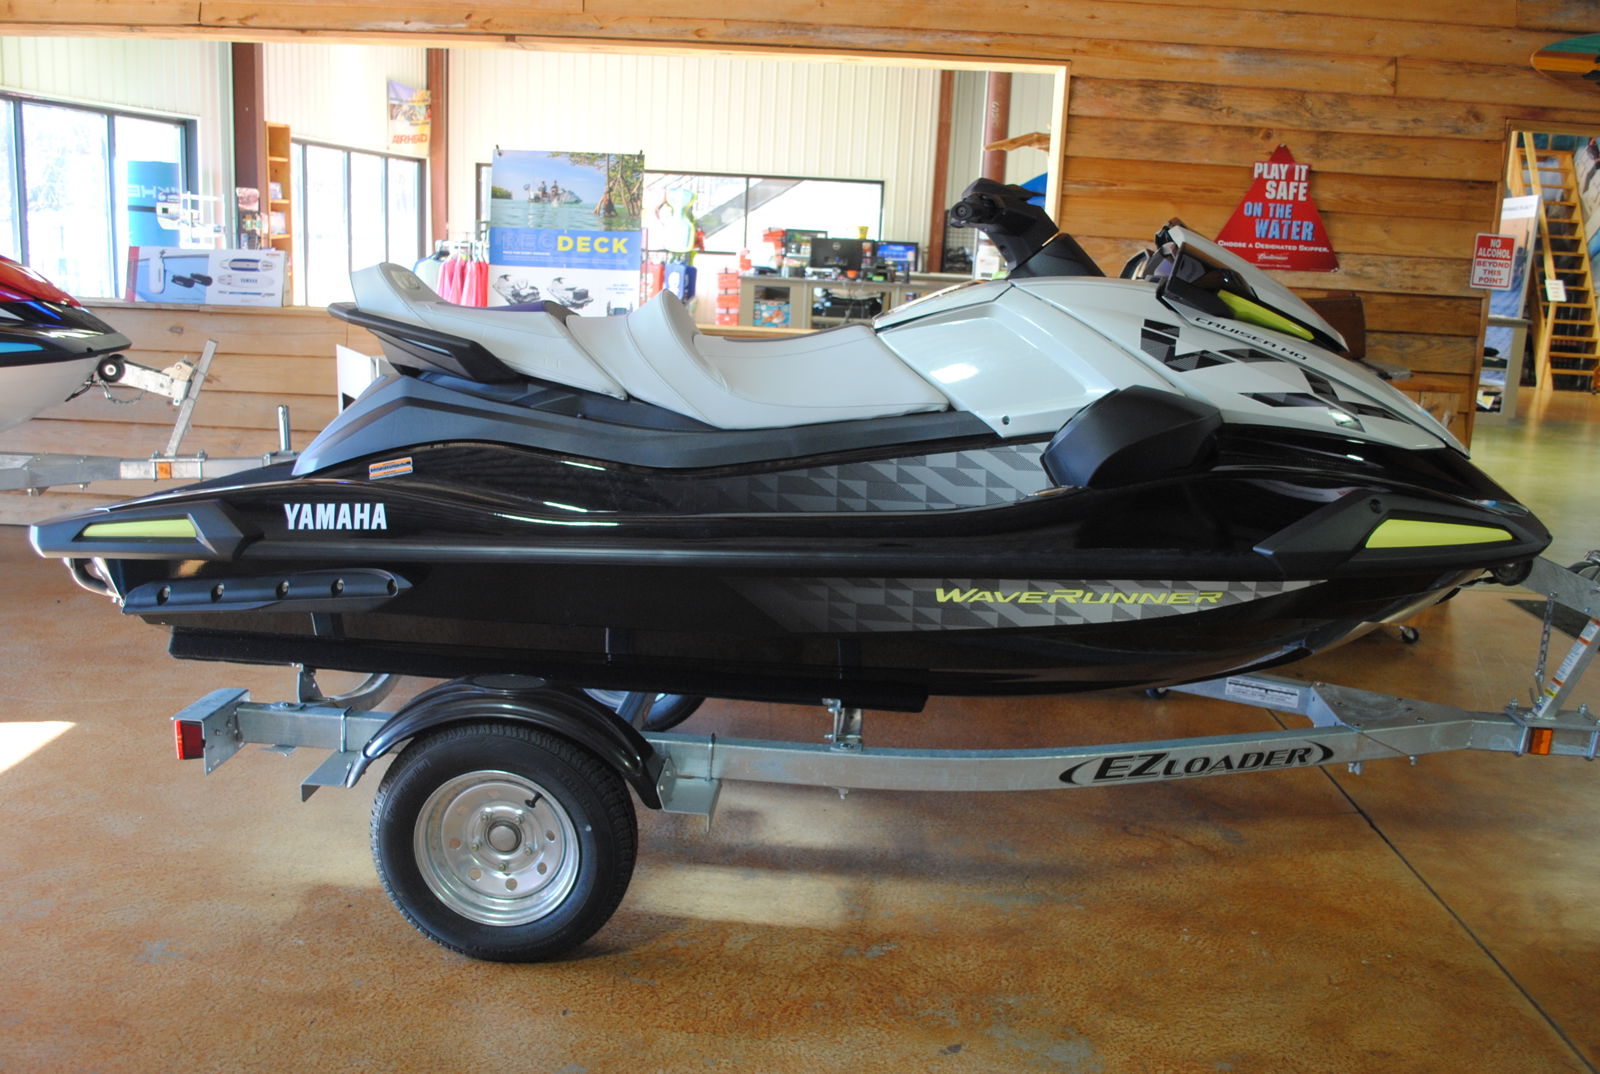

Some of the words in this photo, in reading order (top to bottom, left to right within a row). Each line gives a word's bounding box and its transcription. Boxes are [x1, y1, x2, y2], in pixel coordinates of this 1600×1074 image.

[1253, 162, 1289, 180] PLAY
[1294, 165, 1309, 181] IT
[1265, 181, 1308, 201] SAFE
[1243, 201, 1263, 217] ON
[1268, 203, 1293, 219] THE
[557, 235, 629, 254] DECK
[1490, 239, 1501, 248] NO
[1477, 248, 1511, 258] ALCOHOL
[1476, 260, 1510, 268] BEYOND
[1478, 276, 1504, 284] POINT
[1195, 317, 1277, 348] CRUISER
[1281, 347, 1307, 361] HO
[284, 502, 388, 530] YAMAHA
[935, 587, 1224, 605] WAVERUNNER
